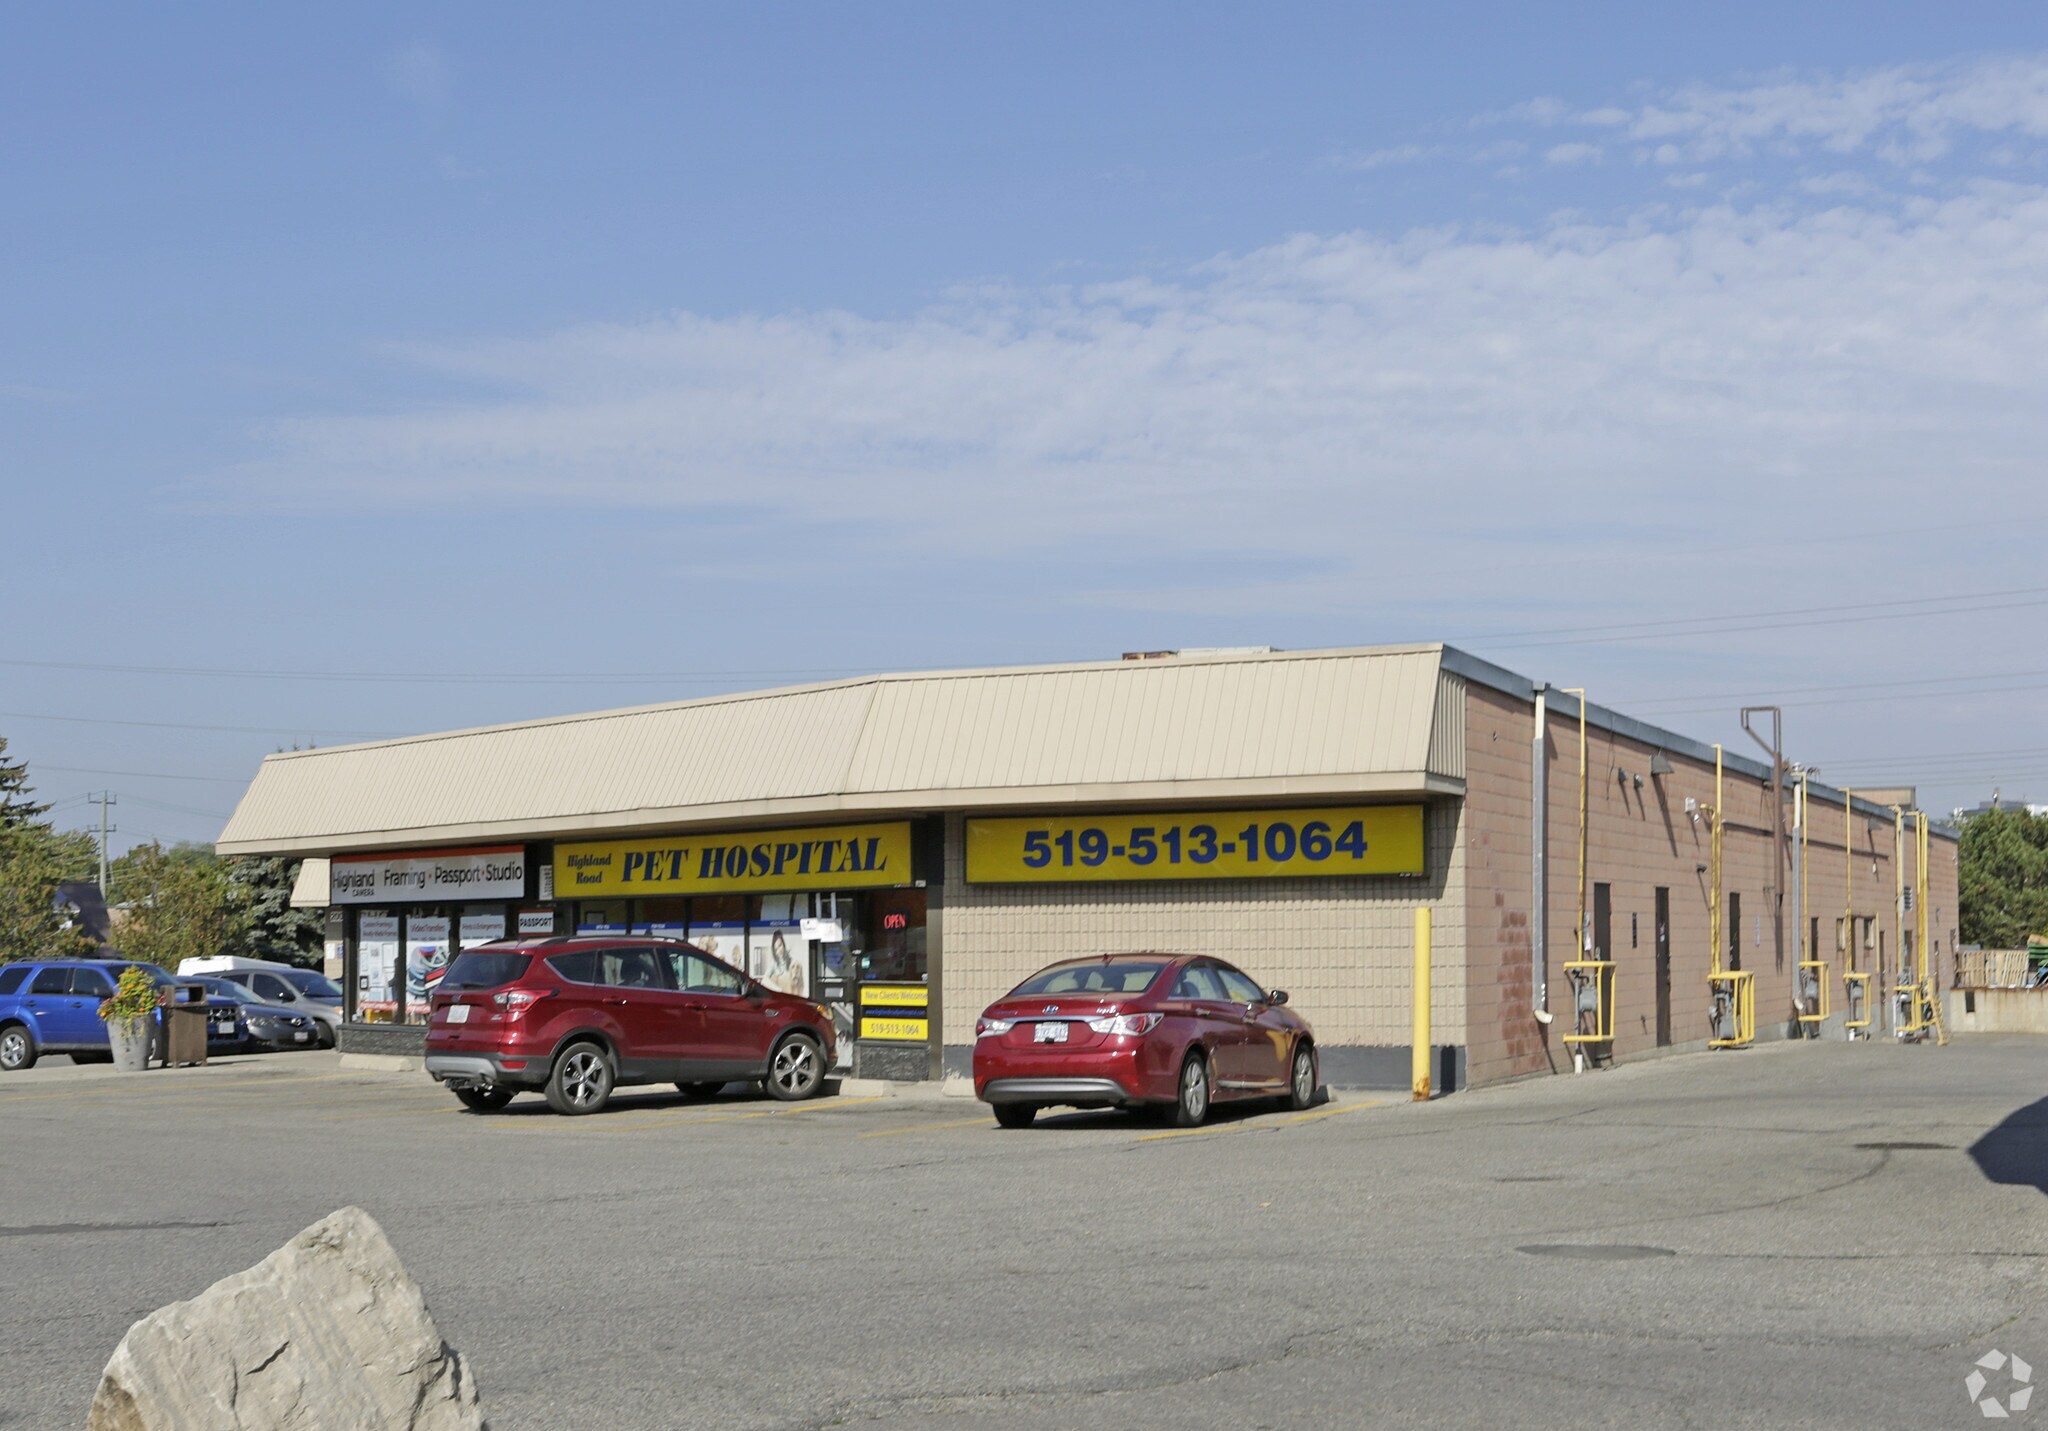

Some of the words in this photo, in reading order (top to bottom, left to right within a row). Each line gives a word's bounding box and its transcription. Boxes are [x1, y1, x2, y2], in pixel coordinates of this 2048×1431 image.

[1022, 821, 1368, 868] 519-513-1064
[567, 853, 612, 869] Highland
[621, 848, 689, 882] PET
[696, 837, 888, 879] HOSPITAL
[383, 866, 425, 889] Framing
[434, 863, 481, 888] Passport
[485, 860, 522, 881] Studio
[576, 870, 603, 884] Road
[519, 917, 552, 927] PASSPORT
[884, 914, 906, 929] OPEN
[871, 1022, 919, 1036] 519-513-1064
